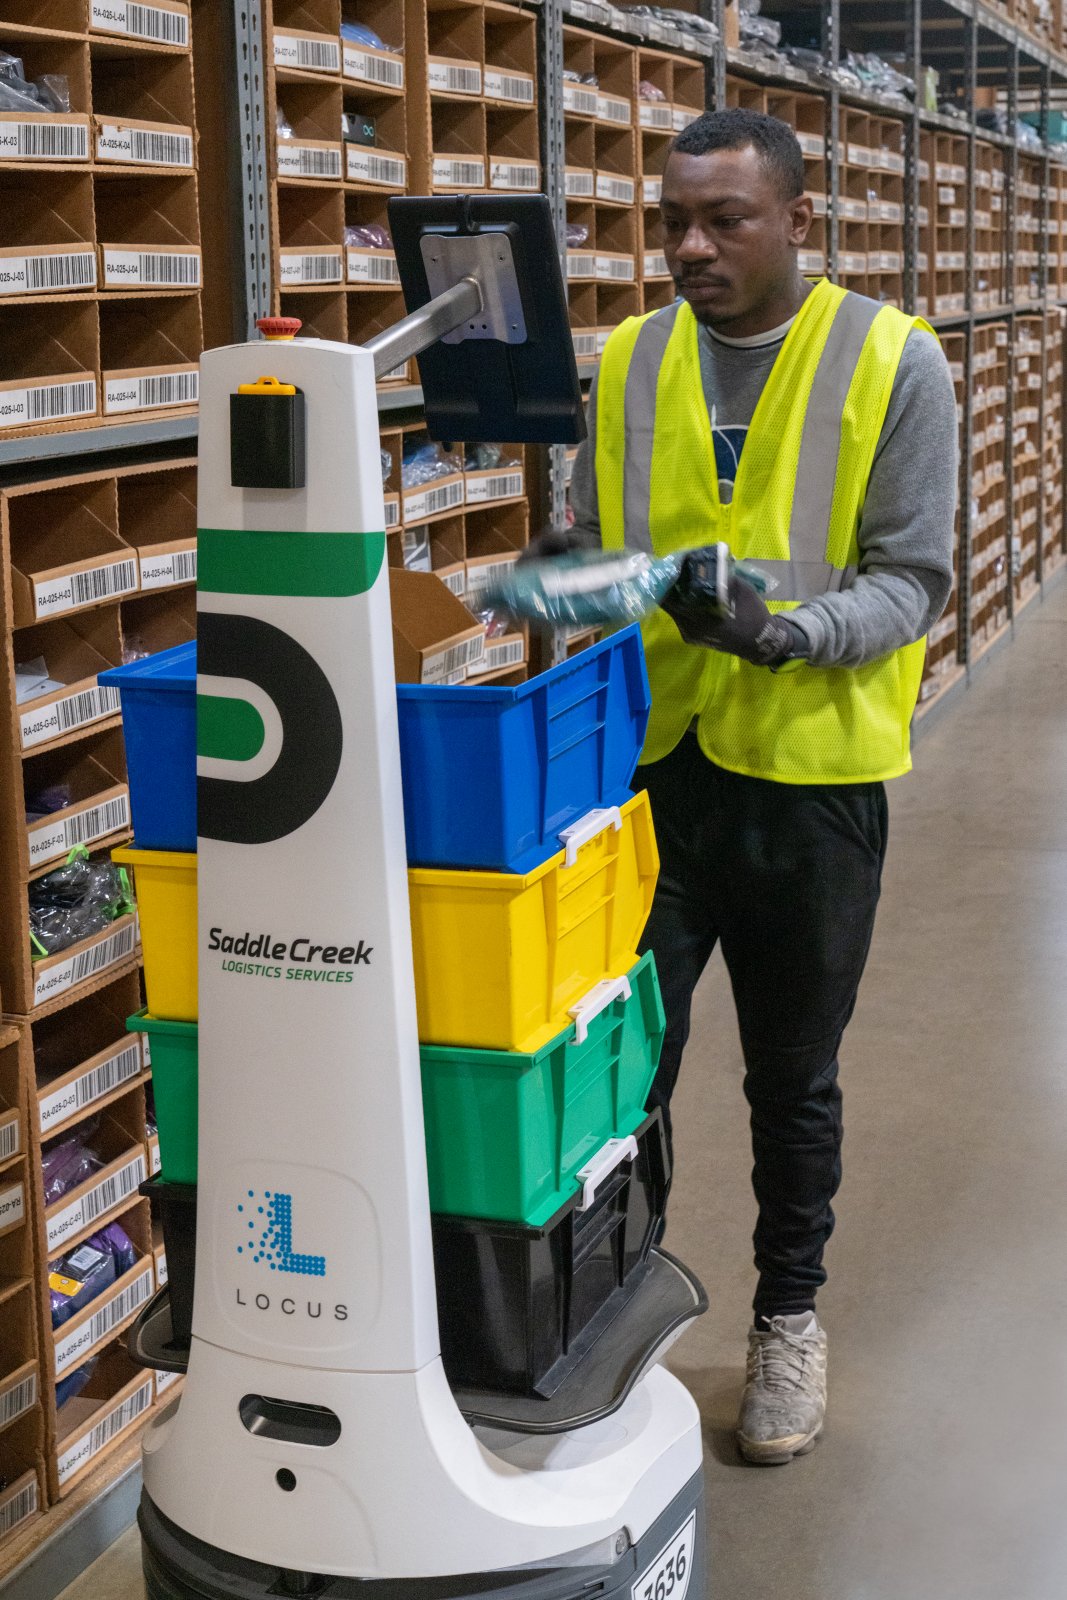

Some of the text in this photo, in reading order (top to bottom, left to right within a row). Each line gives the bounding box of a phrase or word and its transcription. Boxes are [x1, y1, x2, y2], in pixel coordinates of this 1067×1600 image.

[93, 6, 125, 22] RA-025-L-04
[106, 263, 139, 274] RA-025-J-04
[107, 390, 137, 403] RA-025-I-04
[142, 566, 173, 581] RA-025-H-04
[38, 589, 72, 608] RA-025-H-03
[23, 715, 58, 738] RA-025-G-03
[31, 833, 64, 855] RA-025-F-03
[208, 927, 374, 965] Saddle Creek
[36, 969, 72, 995] RA-025-E-03
[222, 959, 354, 983] LOGISTICS SERVICES
[42, 1094, 76, 1122] RA-025-D-03
[48, 1211, 82, 1241] RA-025-C-03
[236, 1288, 348, 1321] LOCUS
[57, 1331, 91, 1365] RA-025-B-03
